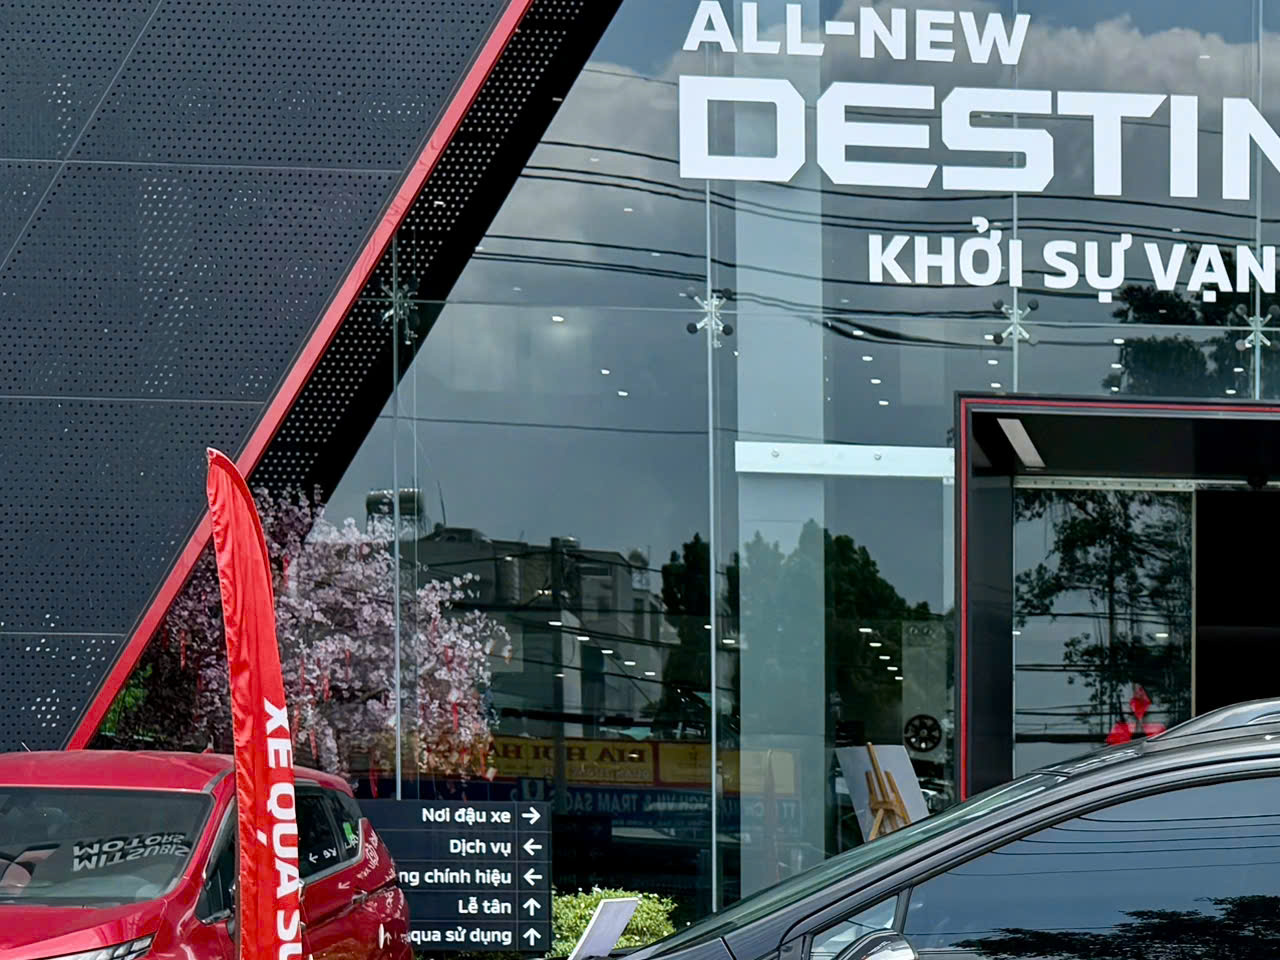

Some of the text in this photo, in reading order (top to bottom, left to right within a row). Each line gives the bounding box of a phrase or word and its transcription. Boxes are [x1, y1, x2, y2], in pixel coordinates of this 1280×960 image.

[682, 0, 1031, 65] ALL-NEW
[868, 216, 1023, 288] KHỞI
[1043, 233, 1133, 304] SỰ
[1145, 242, 1276, 303] VẠN
[264, 697, 294, 769] XE
[422, 807, 511, 826] Nơi đậu xe
[450, 839, 511, 857] Dịch vụ
[399, 868, 511, 887] ng chính hiệu
[458, 896, 511, 914] Lễ tân
[410, 926, 512, 945] qua sử dụng
